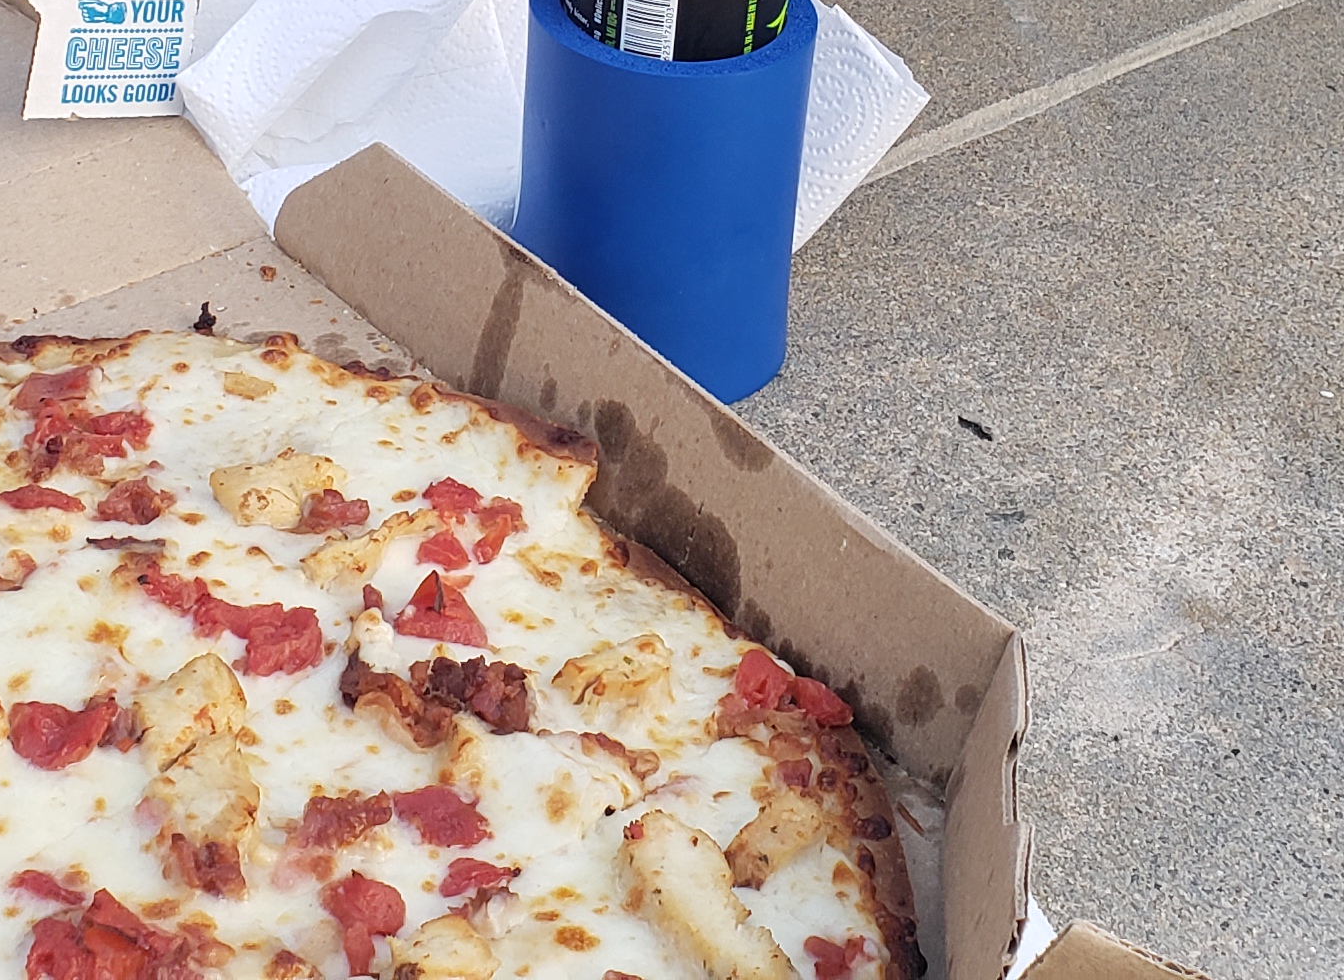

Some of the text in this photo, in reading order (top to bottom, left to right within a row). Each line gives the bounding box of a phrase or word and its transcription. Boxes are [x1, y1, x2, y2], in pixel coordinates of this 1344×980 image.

[131, 0, 186, 24] YOUR
[64, 36, 183, 71] CHEESE
[60, 82, 176, 104] LOOKS GOOD!
